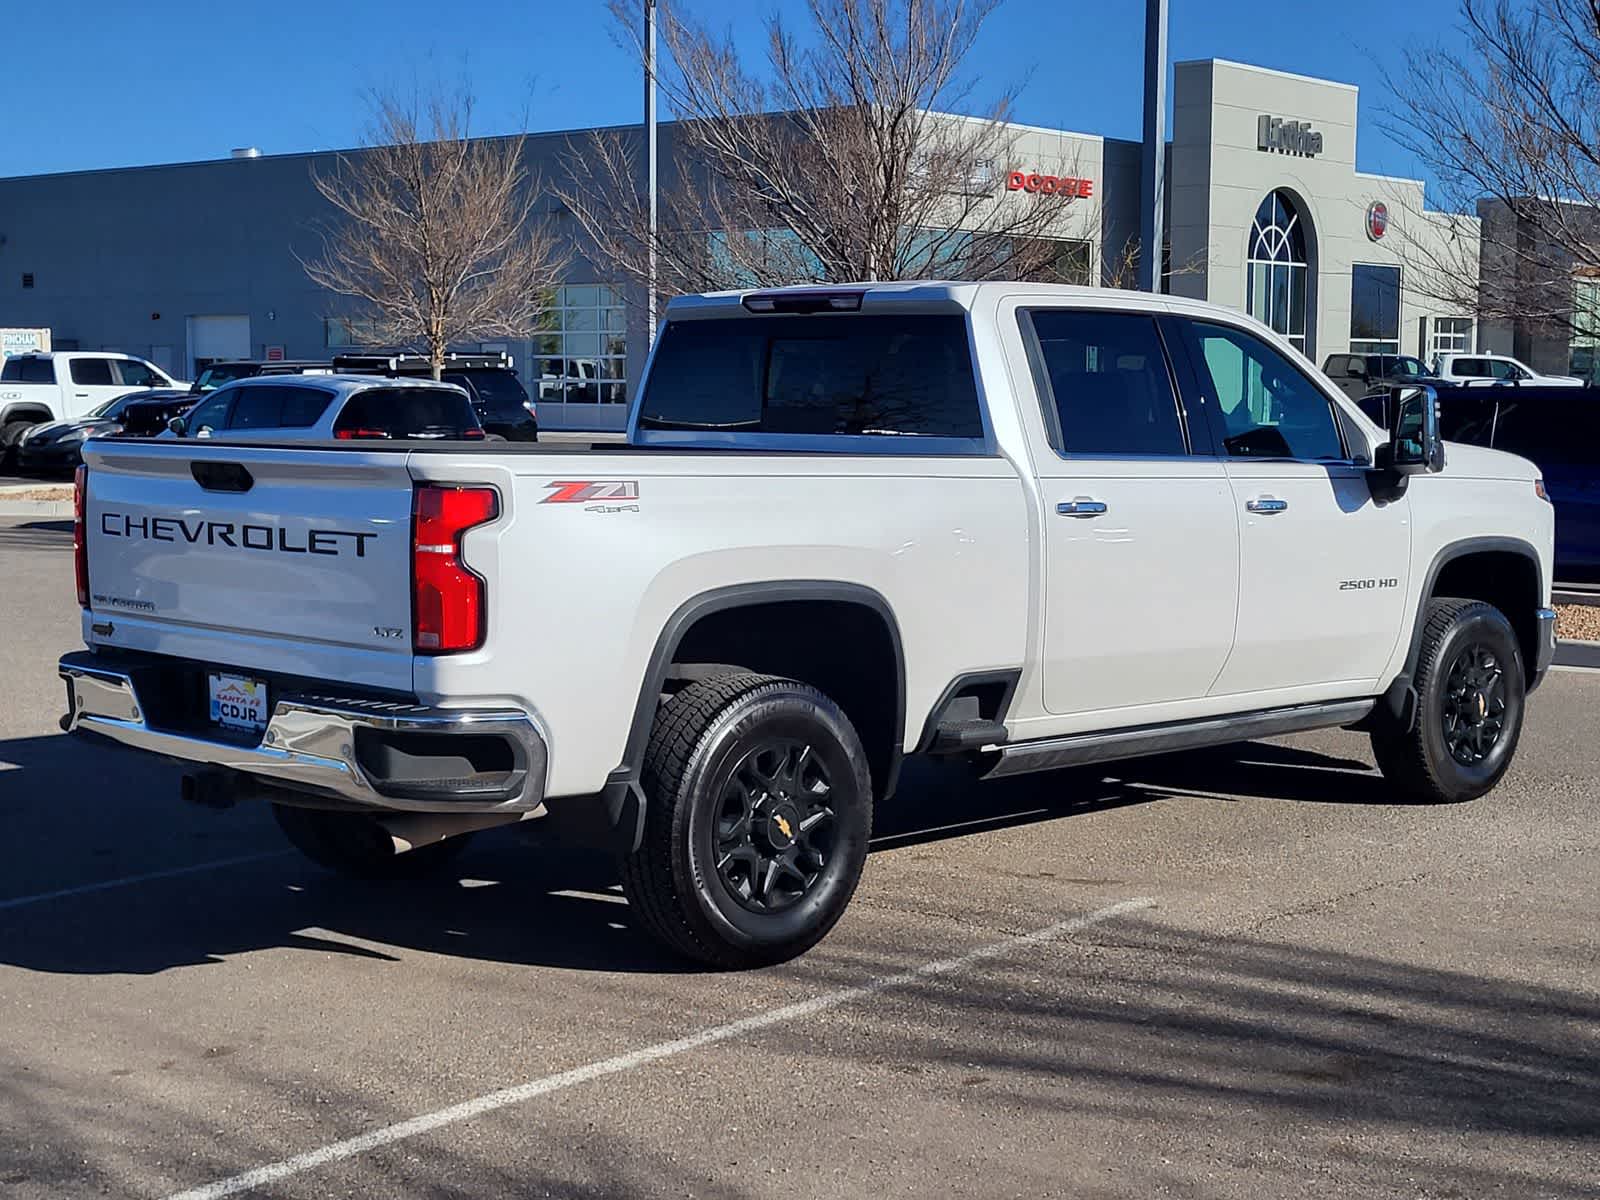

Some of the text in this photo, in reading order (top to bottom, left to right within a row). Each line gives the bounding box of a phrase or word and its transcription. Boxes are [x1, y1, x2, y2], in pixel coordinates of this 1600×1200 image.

[1257, 115, 1322, 155] Lithia
[1008, 172, 1093, 197] DODGE
[537, 480, 640, 504] Z71
[101, 513, 378, 557] CHEVROLET
[1339, 578, 1398, 590] 2500 HD
[216, 694, 247, 705] SANTA
[220, 703, 258, 721] CDJR
